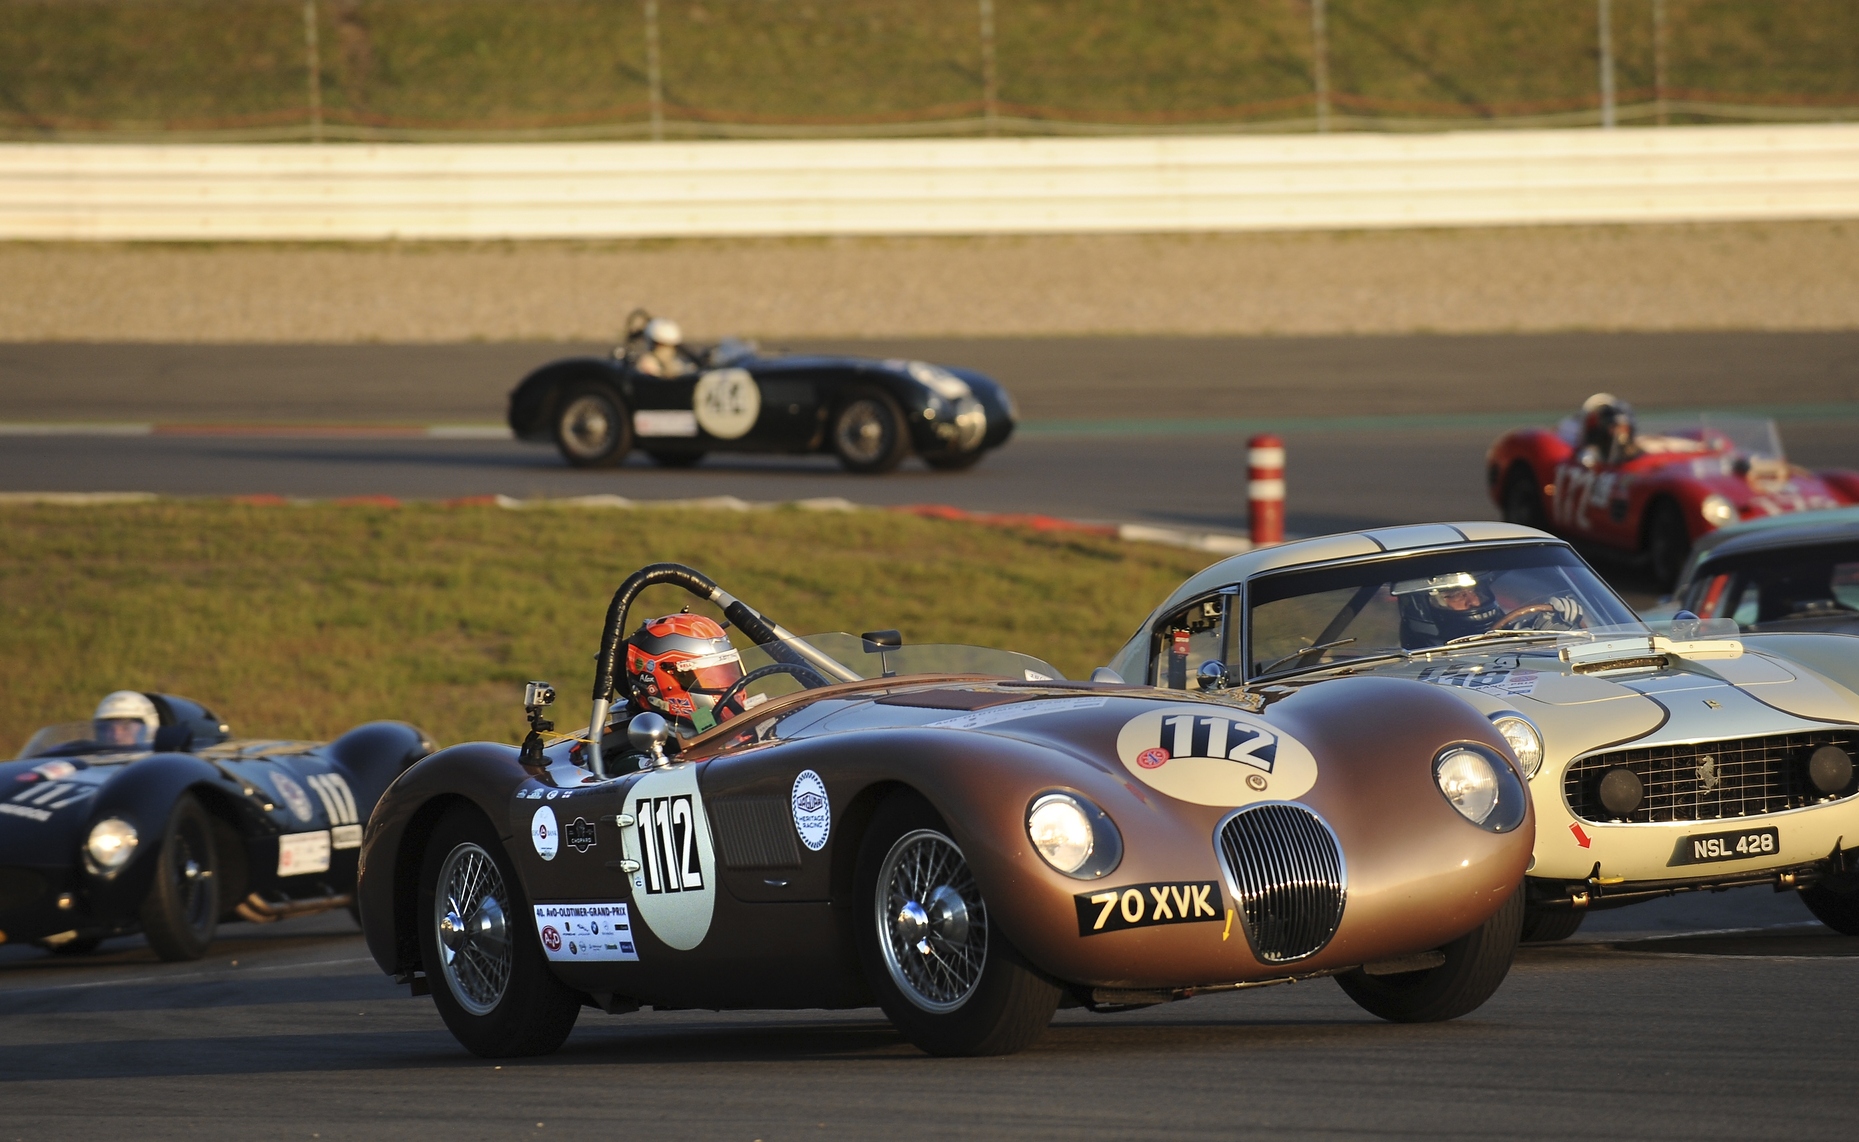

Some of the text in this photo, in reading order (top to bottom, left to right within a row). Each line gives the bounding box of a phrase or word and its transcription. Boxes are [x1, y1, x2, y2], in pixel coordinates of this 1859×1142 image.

[1164, 714, 1275, 773] 112
[637, 797, 702, 892] 112
[1694, 833, 1773, 859] NSL 428
[1091, 884, 1216, 930] 70 XVK
